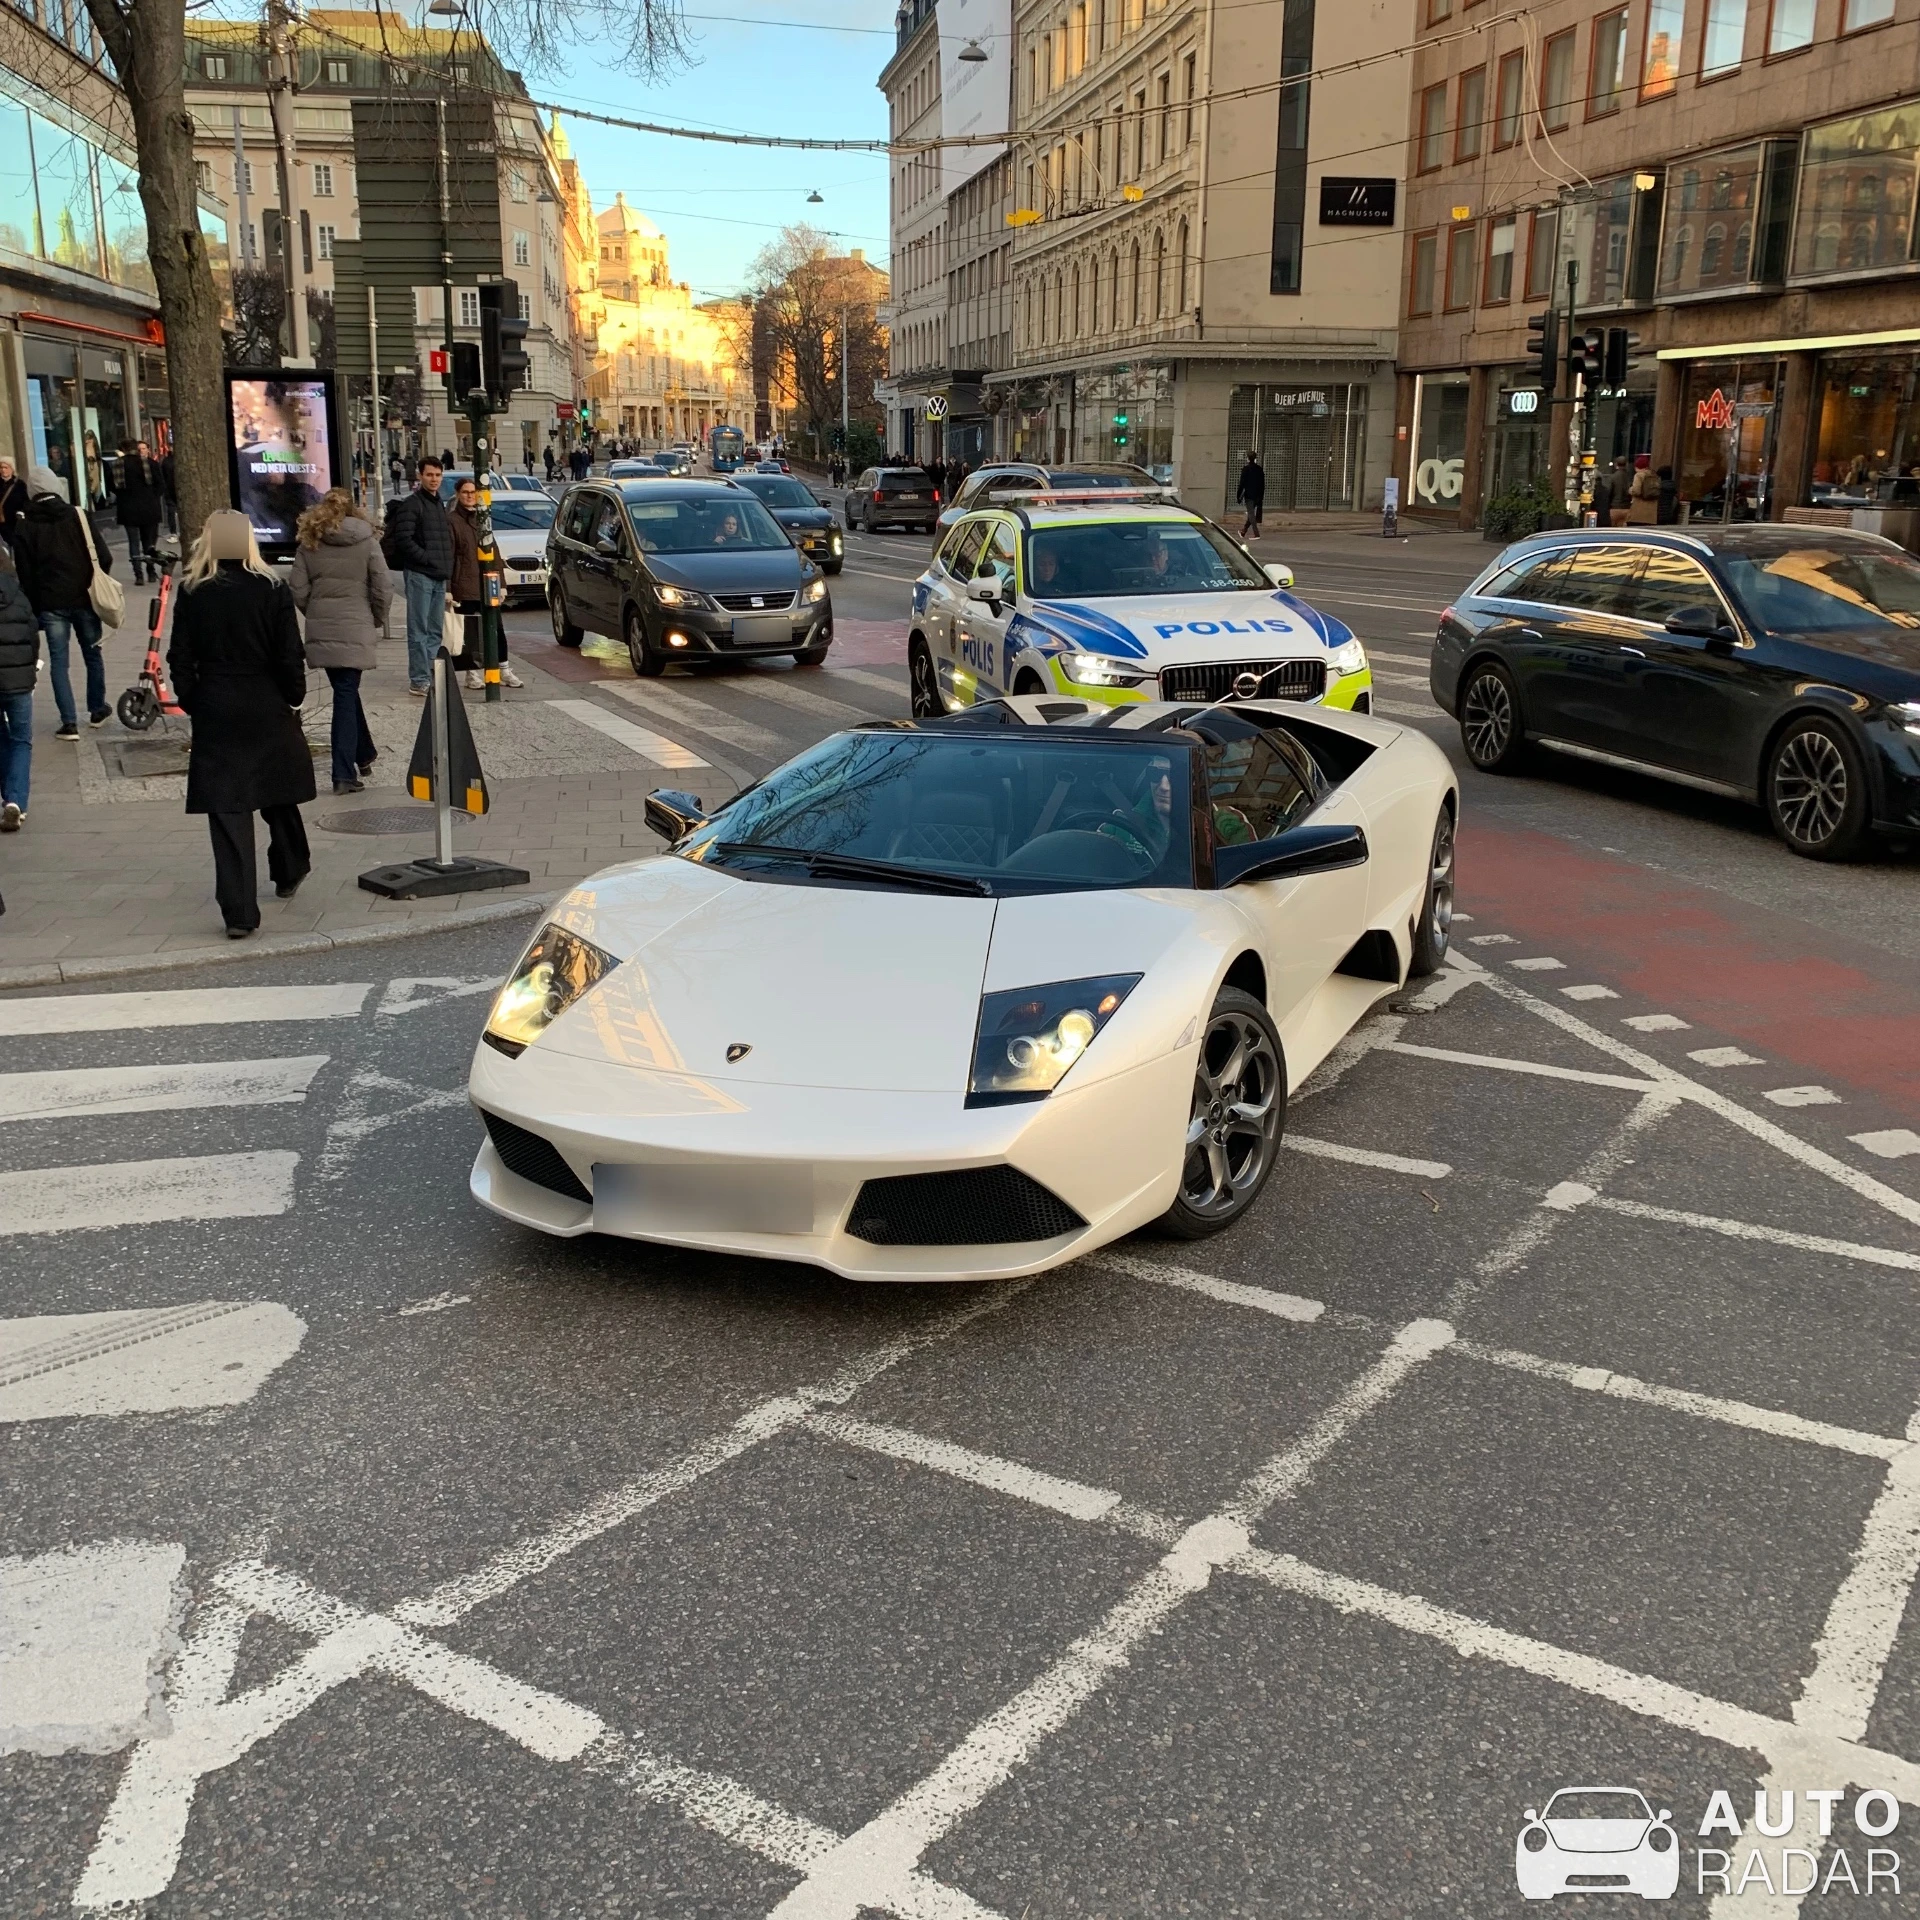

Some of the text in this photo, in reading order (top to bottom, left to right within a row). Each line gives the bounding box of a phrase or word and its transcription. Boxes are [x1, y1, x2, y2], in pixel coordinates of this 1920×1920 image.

[1327, 209, 1388, 217] MAGNUSSON
[1274, 390, 1326, 406] DJERF AVENUE
[1696, 388, 1735, 428] MAX
[250, 462, 316, 474] MED META QUEST 3
[527, 574, 543, 582] BJA
[1200, 580, 1208, 588] 1
[1153, 619, 1294, 639] POLIS
[962, 631, 994, 676] POLIS
